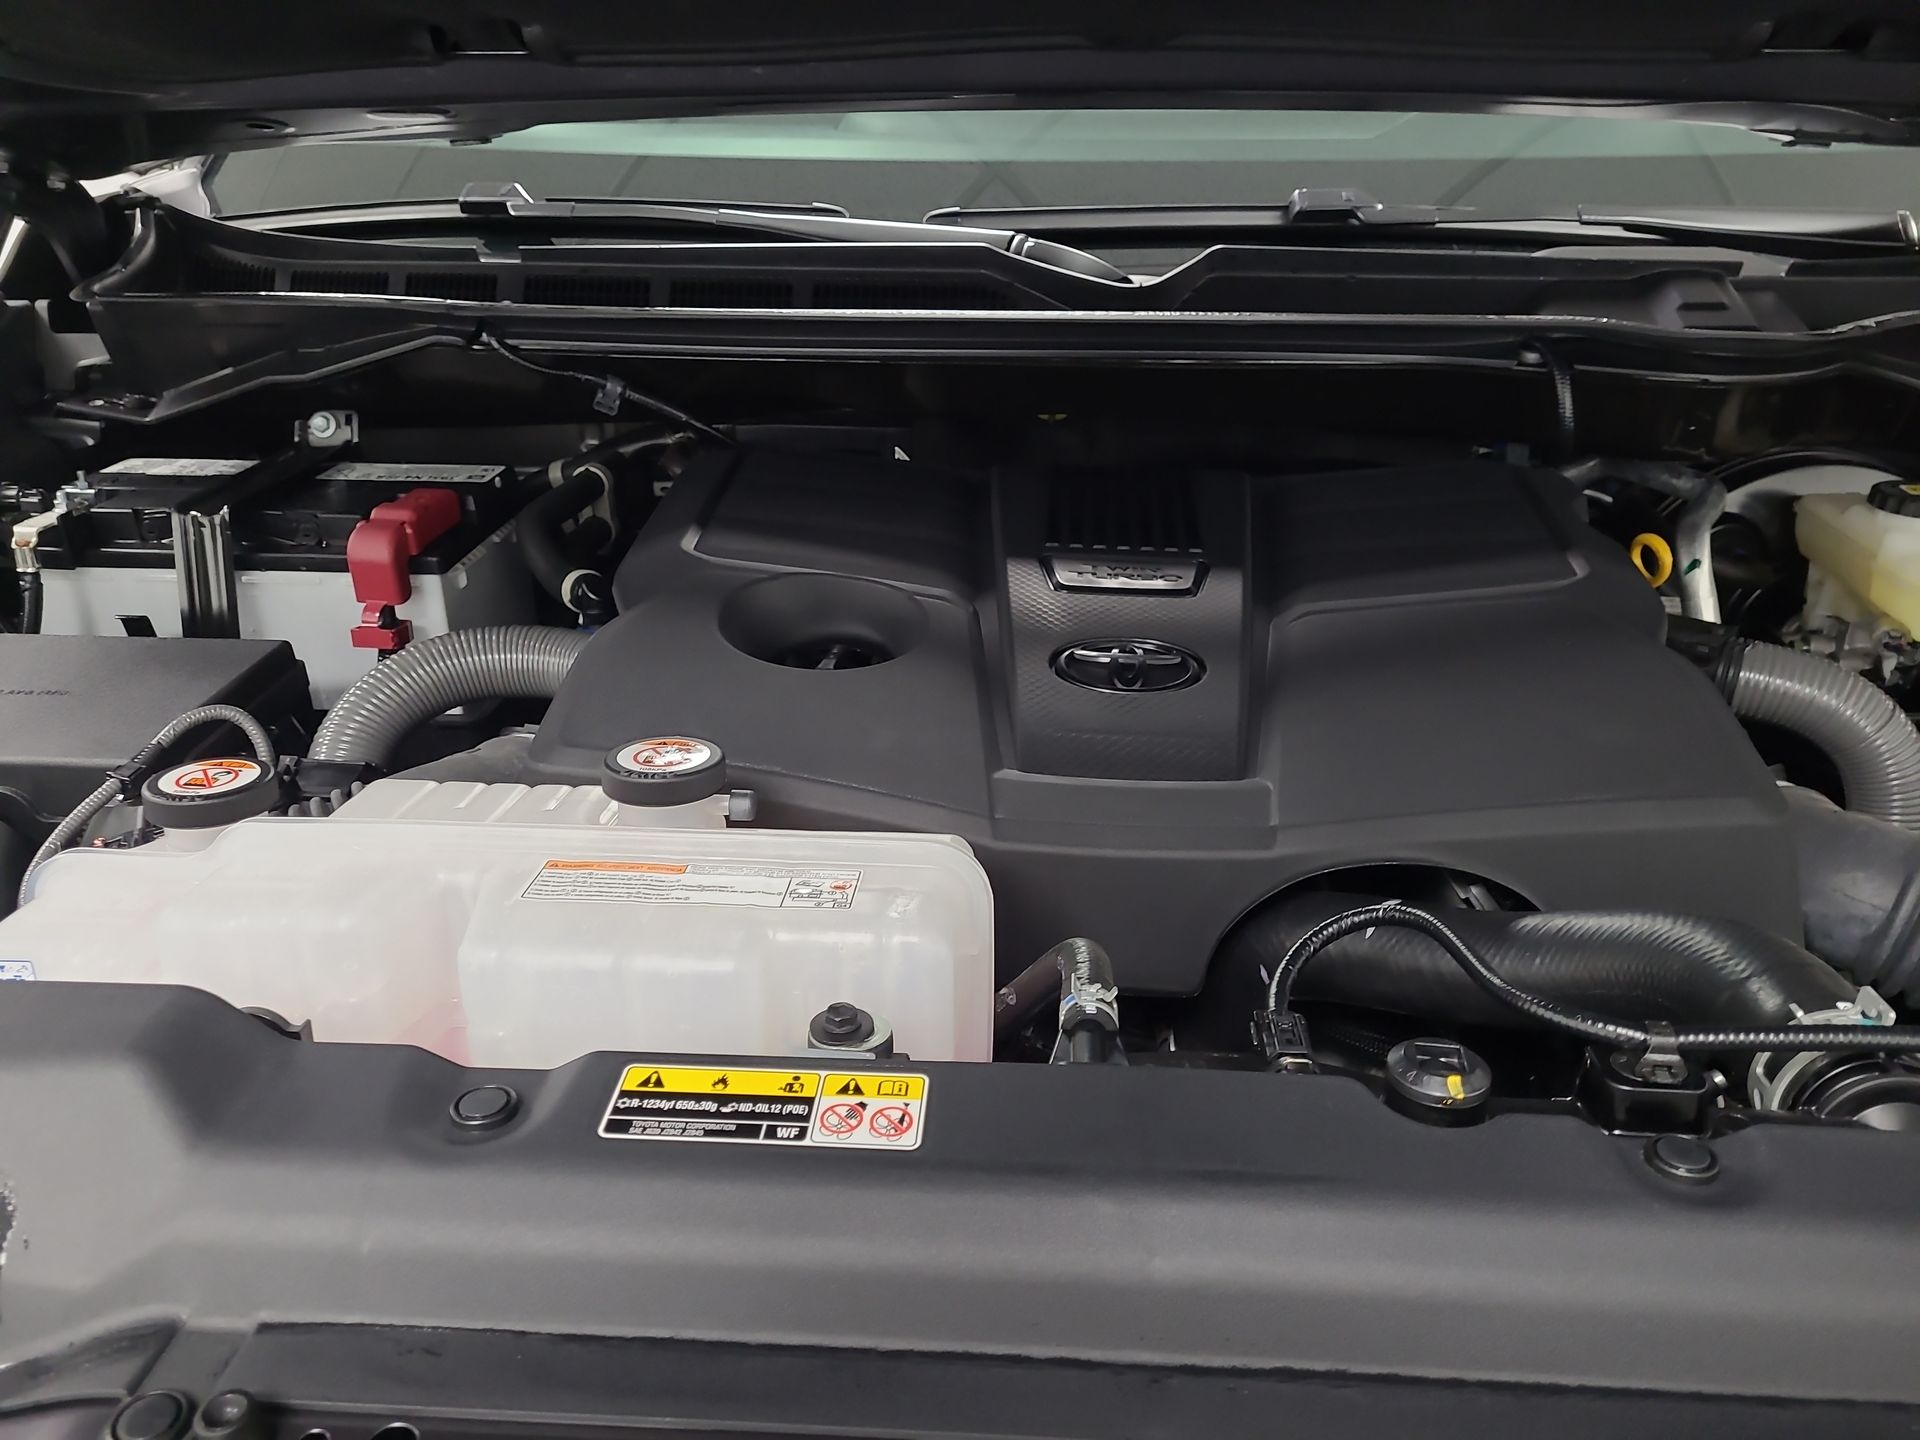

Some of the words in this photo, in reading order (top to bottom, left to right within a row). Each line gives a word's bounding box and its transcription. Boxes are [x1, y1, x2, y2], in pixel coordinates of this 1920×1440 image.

[630, 1098, 676, 1111] R-1234yf
[675, 1100, 719, 1113] 650±30g
[738, 1102, 782, 1114] ND-OIL12
[782, 1104, 809, 1116] (POE)
[632, 1120, 660, 1129] TOYOTA
[660, 1121, 686, 1129] MOTOR
[686, 1122, 737, 1131] CORPORATION
[776, 1126, 800, 1139] WF
